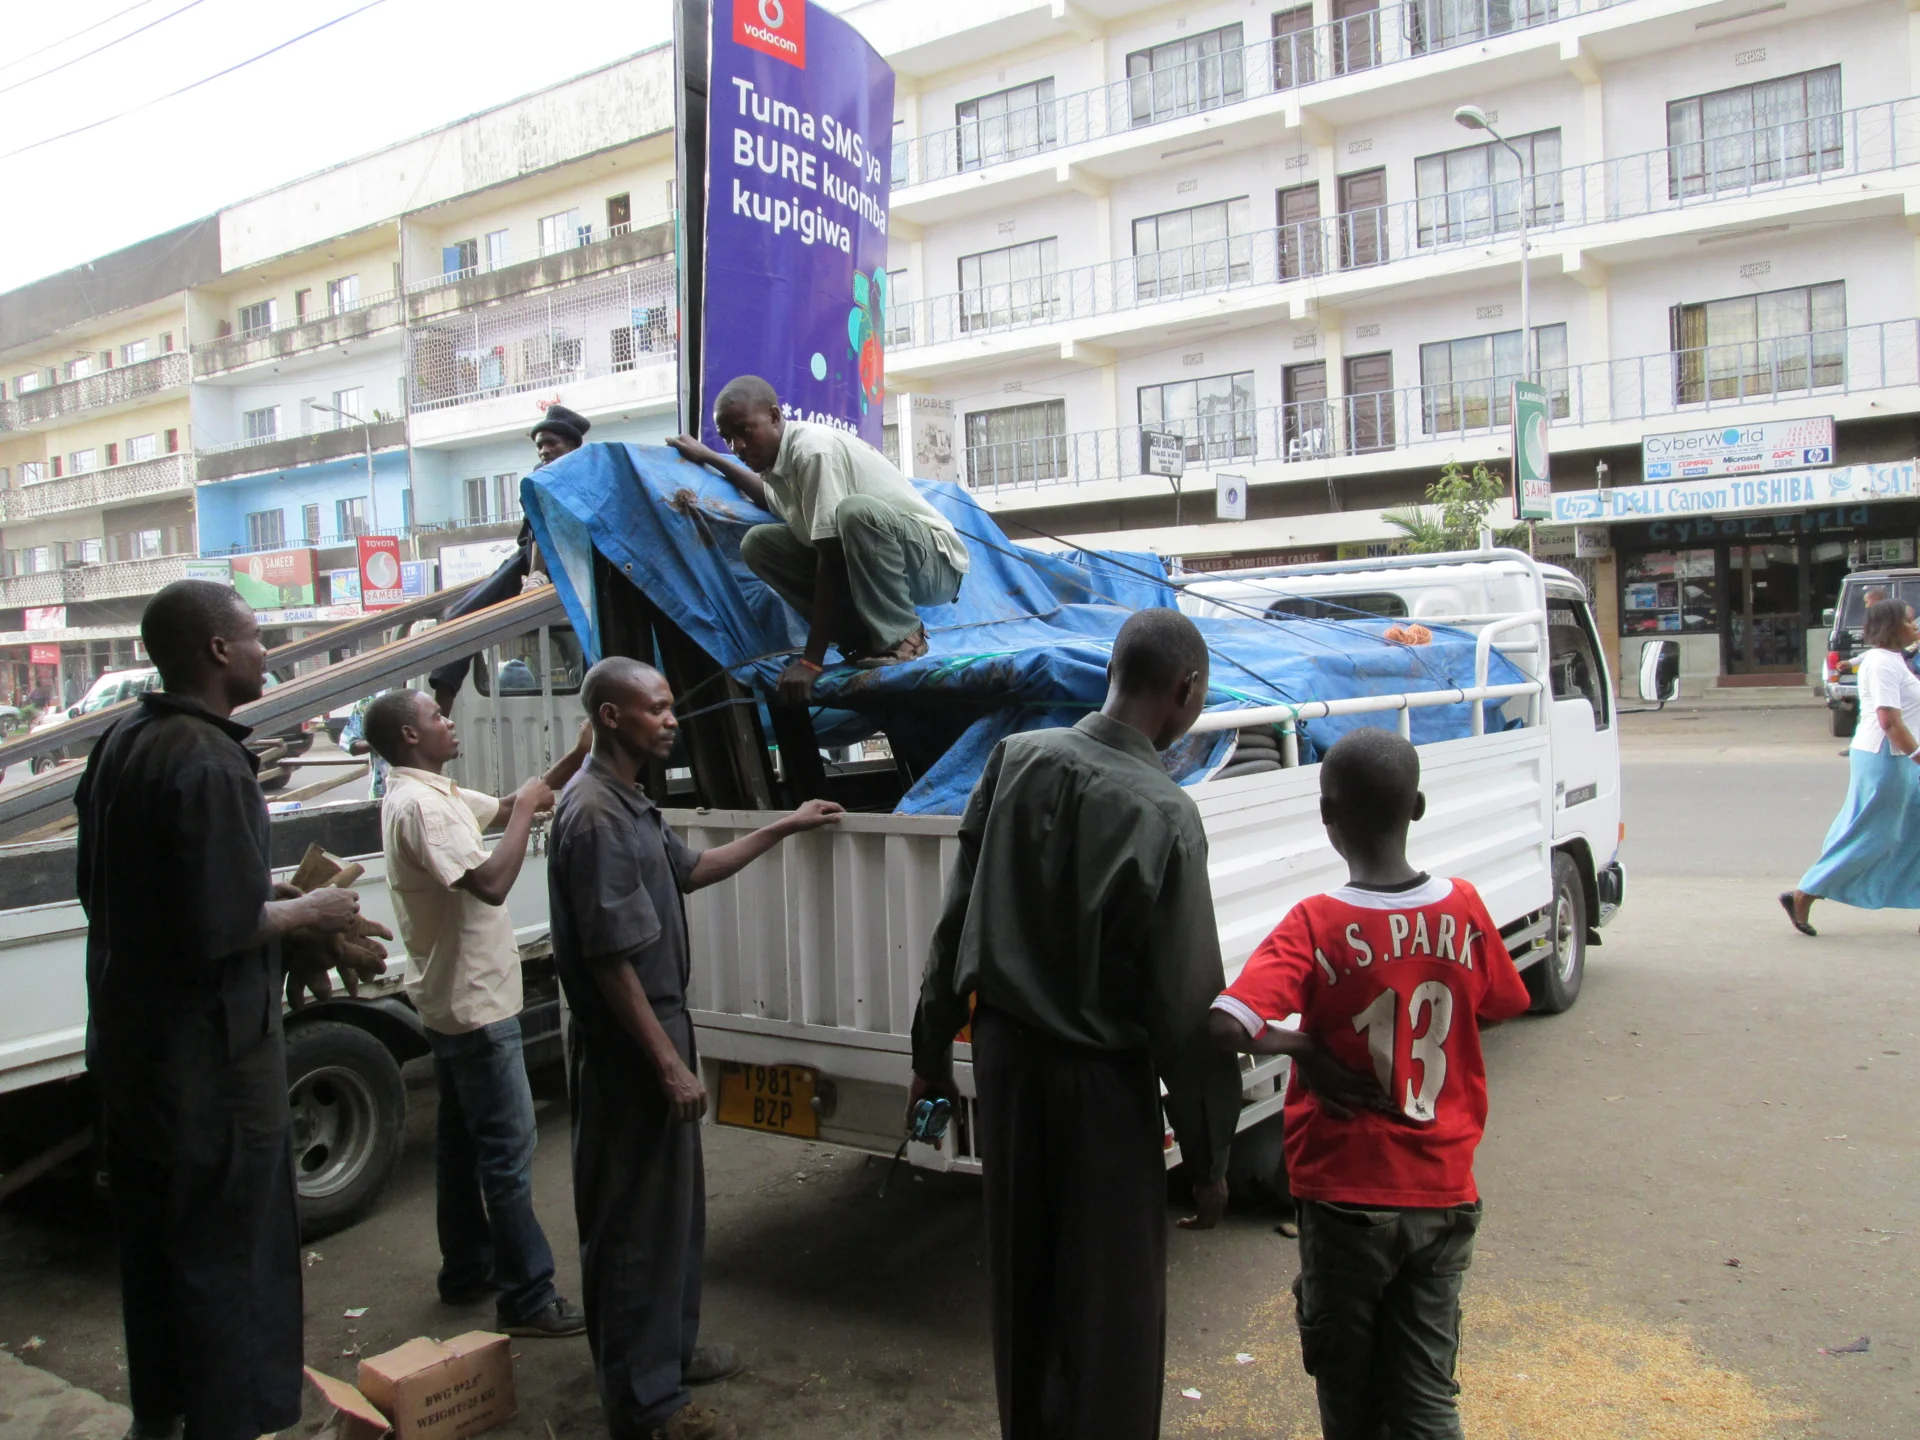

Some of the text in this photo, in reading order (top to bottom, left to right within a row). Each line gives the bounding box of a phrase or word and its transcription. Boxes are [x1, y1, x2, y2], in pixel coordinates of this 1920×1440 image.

[743, 22, 797, 54] vodacom
[732, 76, 881, 185] Tuma SMS ya
[733, 128, 886, 235] BURE kuomba
[732, 178, 850, 253] kupigiwa
[914, 397, 951, 410] NOBLE
[1722, 453, 1763, 463] Microsoft
[1772, 450, 1796, 458] APC
[1677, 458, 1714, 468] COMPAQ
[1726, 463, 1760, 472] Canon
[1774, 459, 1793, 468] IBM
[1565, 497, 1590, 518] hp
[1667, 487, 1727, 512] Canon
[1731, 475, 1815, 507] TOSHIBA
[365, 540, 395, 548] TOYOTA
[265, 555, 295, 569] SAMEER
[365, 590, 402, 600] SAMEER
[284, 610, 313, 622] SCANIA
[1351, 980, 1453, 1122] 13
[743, 1063, 793, 1097] T981
[753, 1096, 792, 1128] BZP
[425, 1387, 452, 1407] BWG
[416, 1402, 466, 1429] WEIGHT:
[480, 1387, 496, 1403] KG
